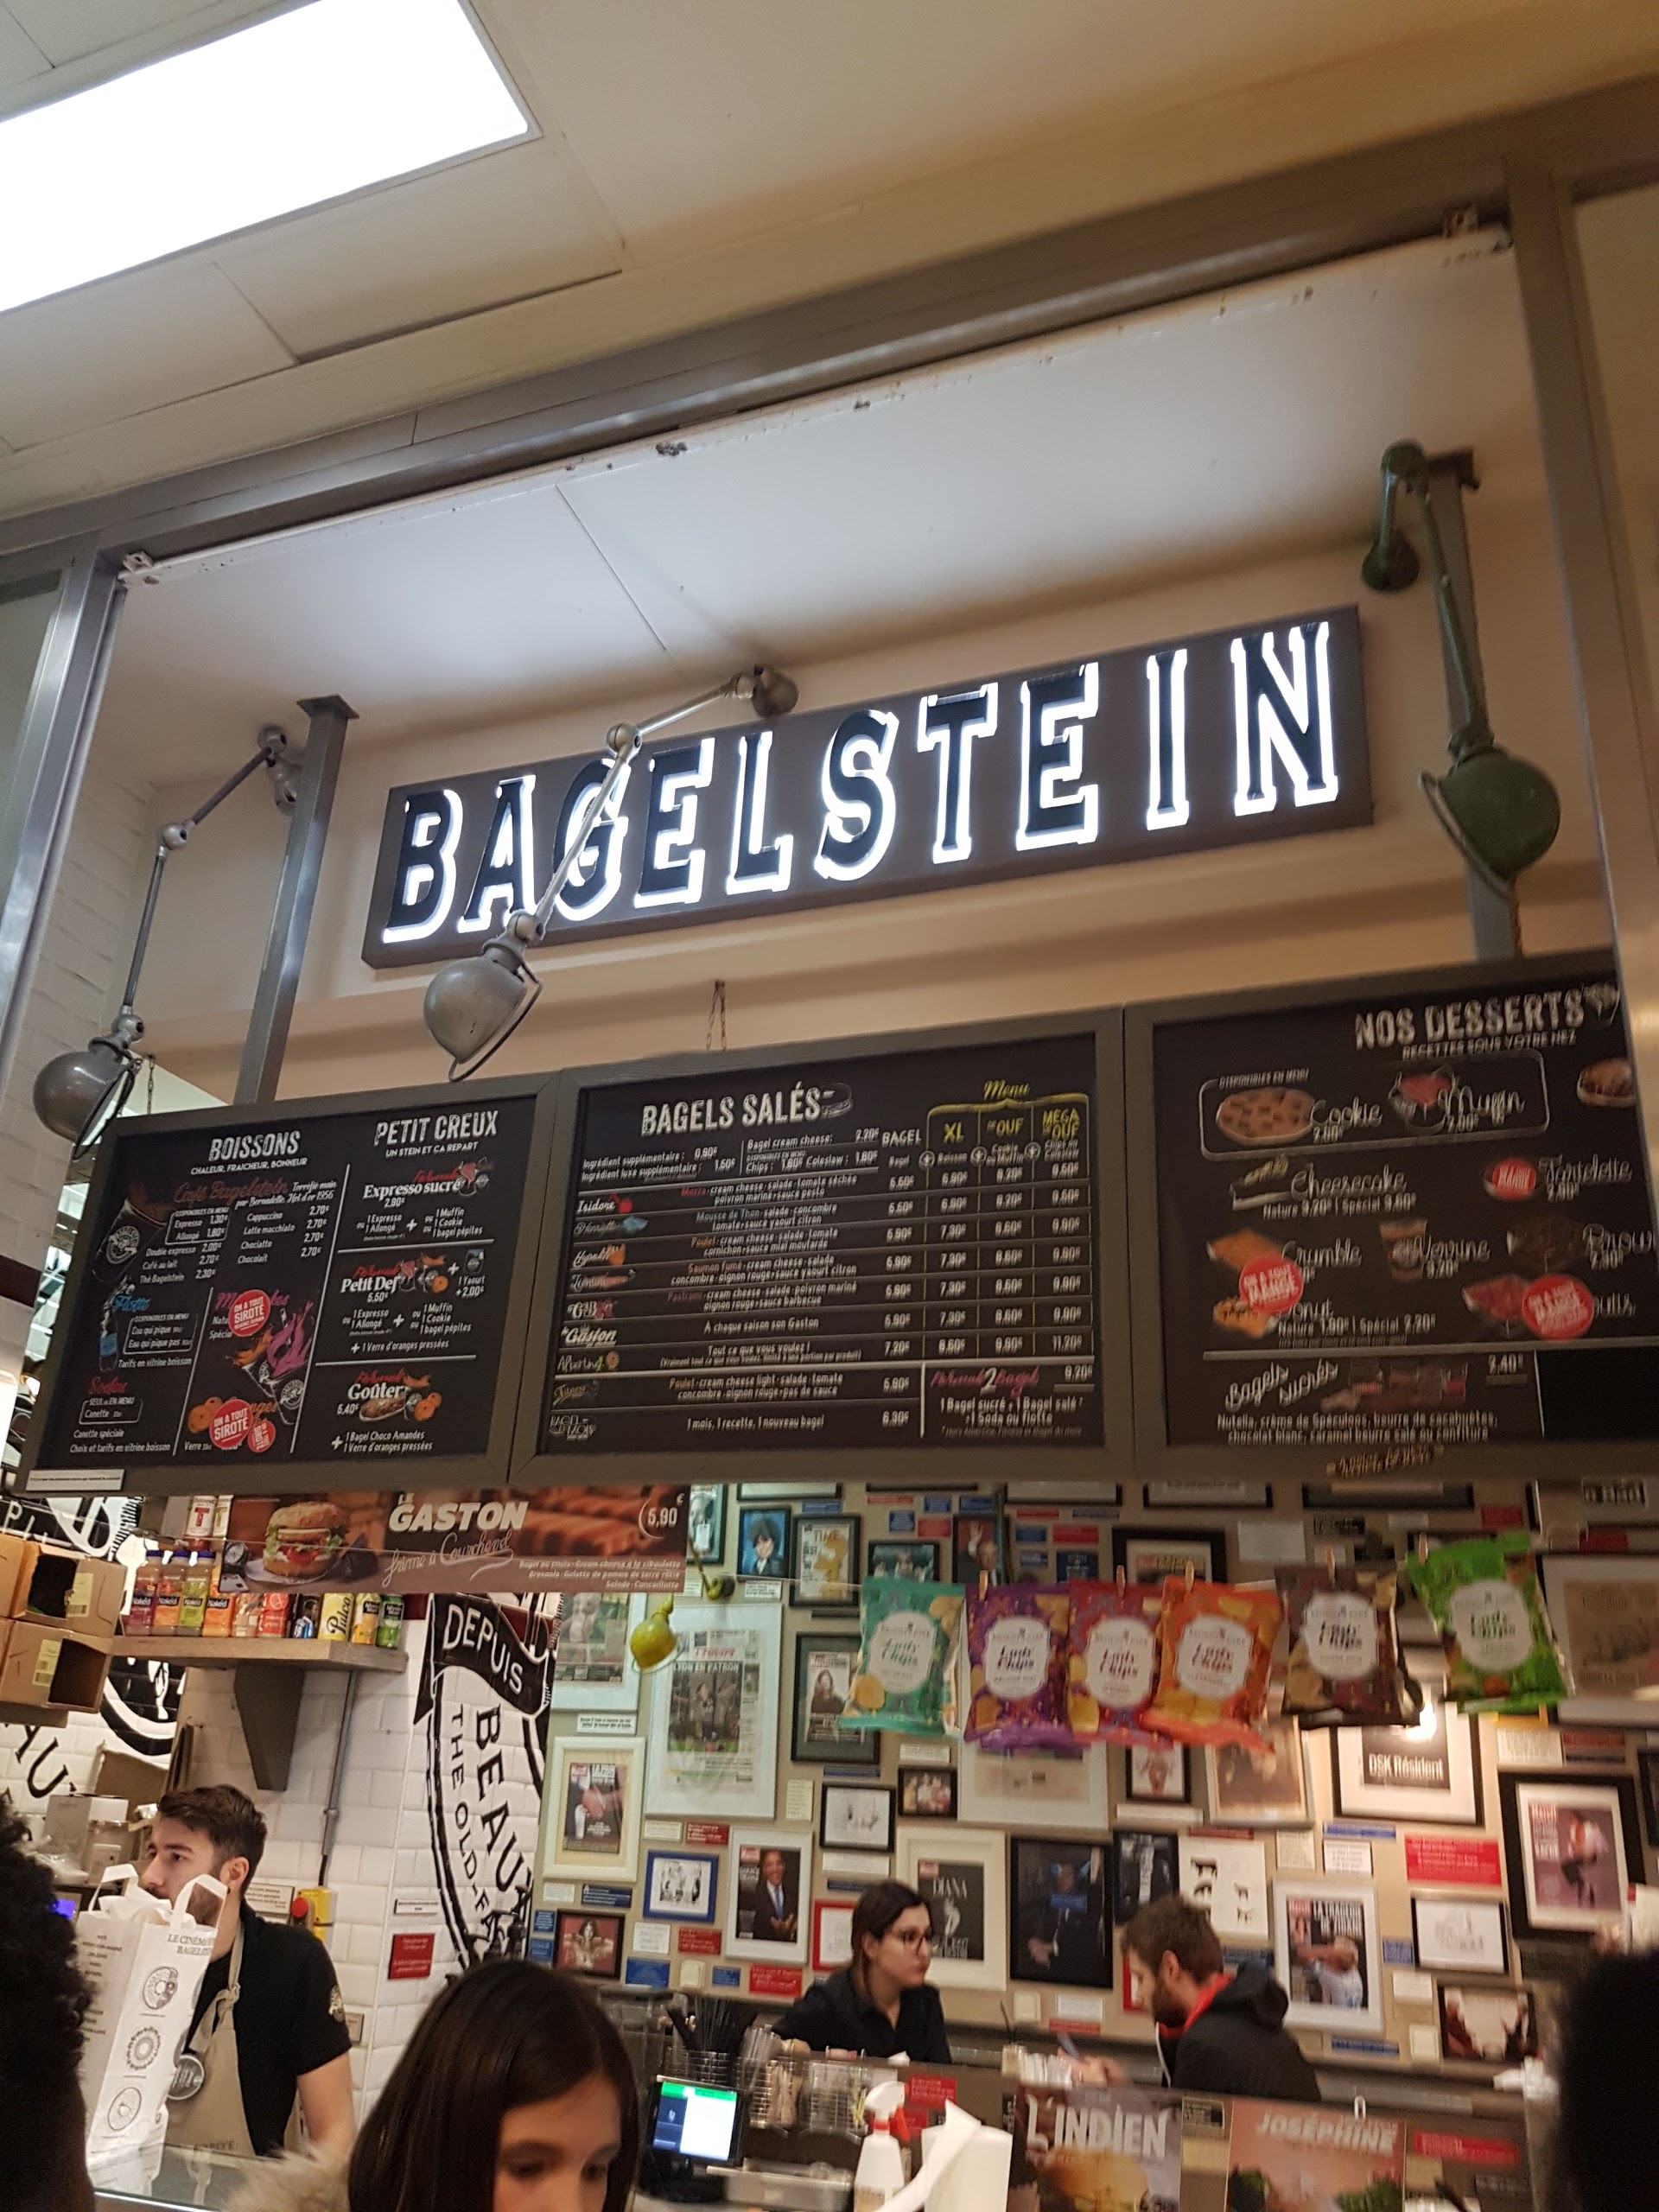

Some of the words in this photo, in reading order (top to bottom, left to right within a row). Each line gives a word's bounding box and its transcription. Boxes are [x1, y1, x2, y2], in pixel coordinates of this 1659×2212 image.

[382, 620, 1339, 944] BAGELSTEIN
[1356, 1007, 1415, 1050] NOS
[1425, 989, 1584, 1043] DESSERTS
[983, 1079, 1030, 1101] Menu
[641, 1096, 735, 1138] BAGELS
[742, 1081, 821, 1128] SALÉS
[1042, 1108, 1081, 1127] MEGA
[1311, 1096, 1382, 1128] Cookie
[373, 1117, 431, 1147] PETIT
[435, 1109, 499, 1141] CREUX
[943, 1121, 965, 1143] XL
[996, 1116, 1025, 1138] OUF
[208, 1130, 301, 1161] BOISSONS
[747, 1137, 772, 1153] Bagel
[772, 1136, 798, 1148] cream
[881, 1128, 923, 1148] BAGEL
[386, 1148, 398, 1159] UN
[399, 1147, 422, 1157] STEIN
[423, 1145, 432, 1154] ET
[447, 1141, 479, 1154] REPART
[270, 1158, 308, 1169] BONHEUR
[582, 1156, 621, 1170] Ingrédient
[622, 1151, 681, 1166] supplémentaire
[746, 1161, 769, 1176] Chips
[581, 1168, 620, 1183] Ingrédient
[620, 1166, 638, 1177] luxe
[363, 1183, 423, 1202] Expresso
[423, 1178, 461, 1194] sucré
[709, 1185, 735, 1198] cream
[735, 1179, 764, 1193] cheese
[767, 1179, 793, 1193] salade
[797, 1175, 827, 1189] tomate
[830, 1173, 858, 1187] séchée
[776, 1189, 801, 1202] sauce
[801, 1186, 825, 1202] pesto
[317, 1190, 336, 1201] 1956
[441, 1207, 465, 1218] Muffin
[577, 1198, 616, 1213] Isidore
[764, 1205, 790, 1218] salade
[791, 1202, 838, 1217] concombre
[175, 1220, 203, 1230] Expresso
[247, 1211, 284, 1224] Cappuccino
[372, 1213, 403, 1225] Expresso
[440, 1217, 463, 1228] Cookie
[769, 1215, 796, 1231] yaourt
[797, 1212, 823, 1227] citron
[244, 1226, 262, 1236] Latte
[262, 1223, 296, 1235] macchiato
[437, 1226, 458, 1239] bagel
[457, 1224, 484, 1239] pépites
[168, 1247, 197, 1257] expresso
[788, 1238, 830, 1252] moutarde
[671, 1271, 715, 1287] concombre
[718, 1270, 747, 1285] oignon
[830, 1262, 858, 1278] citron
[340, 1275, 375, 1294] Petit
[429, 1301, 454, 1313] Muffin
[784, 1293, 823, 1307] barbecue
[233, 1306, 265, 1324] SIROTE
[358, 1308, 390, 1320] Expresso
[427, 1312, 452, 1324] Cookie
[424, 1322, 444, 1337] bagel
[445, 1322, 473, 1335] pépites
[713, 1320, 743, 1337] chaque
[743, 1319, 771, 1332] saison
[771, 1319, 787, 1331] son
[787, 1316, 821, 1332] Gaston
[367, 1342, 386, 1352] Verre
[419, 1338, 450, 1352] pressées
[708, 1344, 728, 1358] Tout
[756, 1343, 777, 1355] vous
[778, 1340, 806, 1353] voulez
[347, 1382, 407, 1401] Goûter
[677, 1387, 723, 1401] concombre
[946, 1396, 977, 1416] Bagel
[977, 1396, 1007, 1414] sucré
[213, 1418, 251, 1441] SIROTE
[762, 1417, 800, 1430] nouveau
[800, 1414, 825, 1432] bagel
[350, 1430, 370, 1443] Bagel
[370, 1430, 391, 1442] Choco
[391, 1428, 427, 1441] Amandes
[349, 1442, 368, 1454] Verre
[401, 1440, 435, 1454] pressées
[194, 1506, 211, 1528] T
[389, 1501, 530, 1533] GASTON
[327, 1596, 352, 1636] Pulco
[442, 1603, 524, 1695] DEPUIS
[451, 1703, 465, 1791] THE
[1369, 1752, 1392, 1778] DSK
[1027, 2093, 1173, 2160] L'INDIEN
